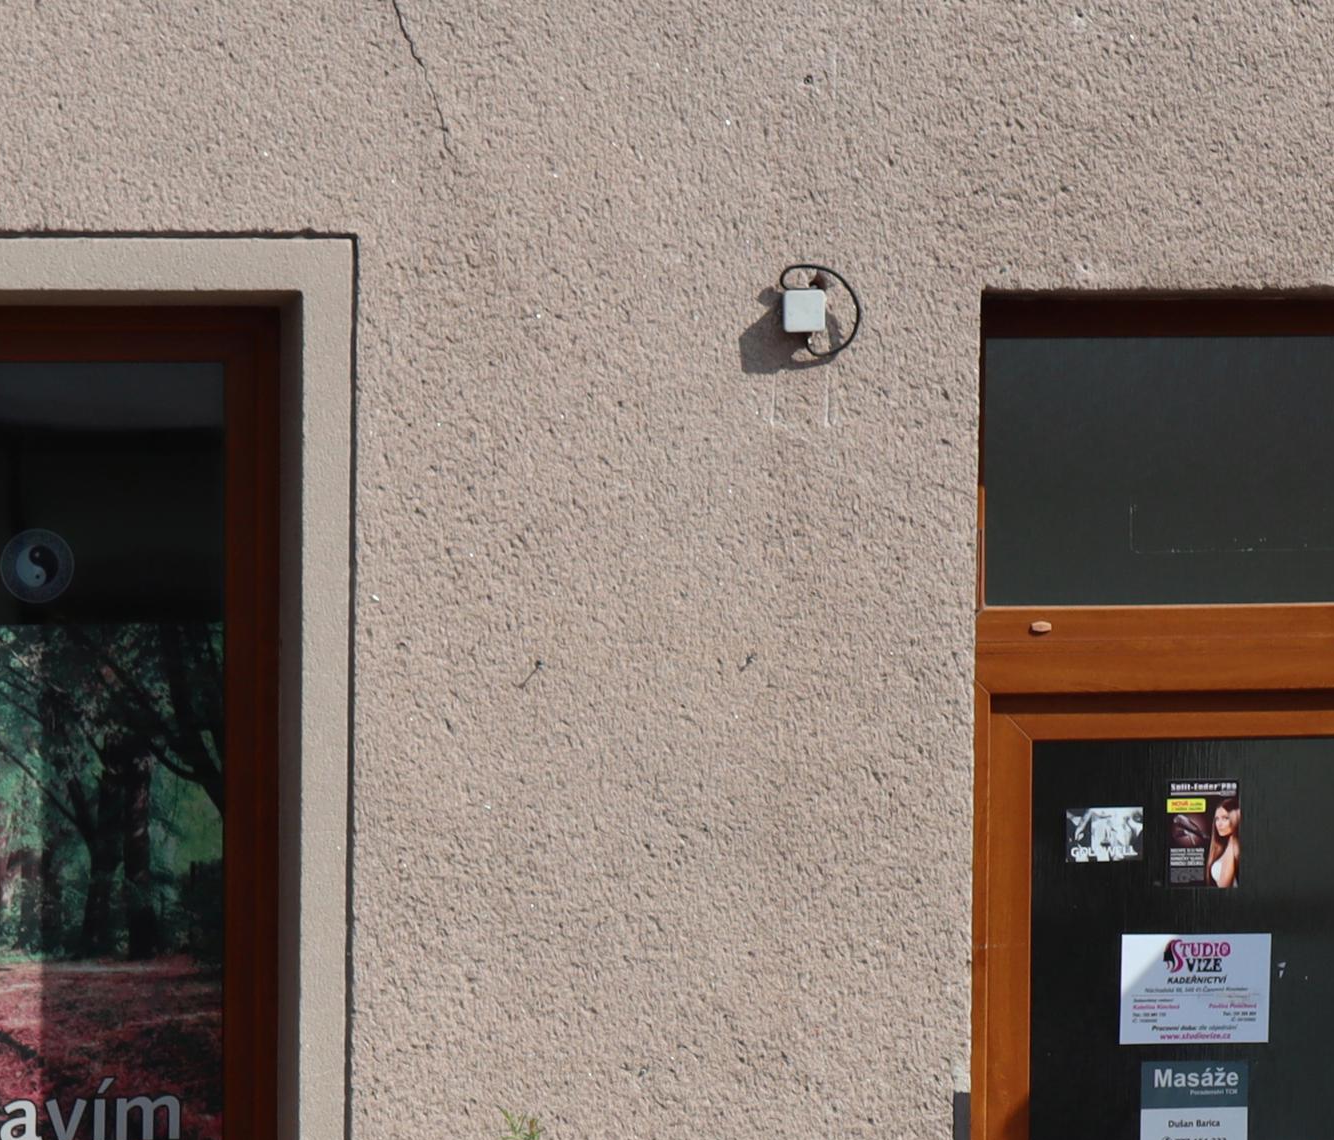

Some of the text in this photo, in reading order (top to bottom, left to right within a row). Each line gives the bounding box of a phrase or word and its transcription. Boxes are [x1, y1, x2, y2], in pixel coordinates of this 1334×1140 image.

[1071, 847, 1138, 857] GOLWELL
[1186, 958, 1223, 972] VIZE
[1167, 975, 1227, 984] KADEŘNICTVÍ
[1154, 1067, 1239, 1088] Masáže
[1168, 1120, 1194, 1128] Dušan
